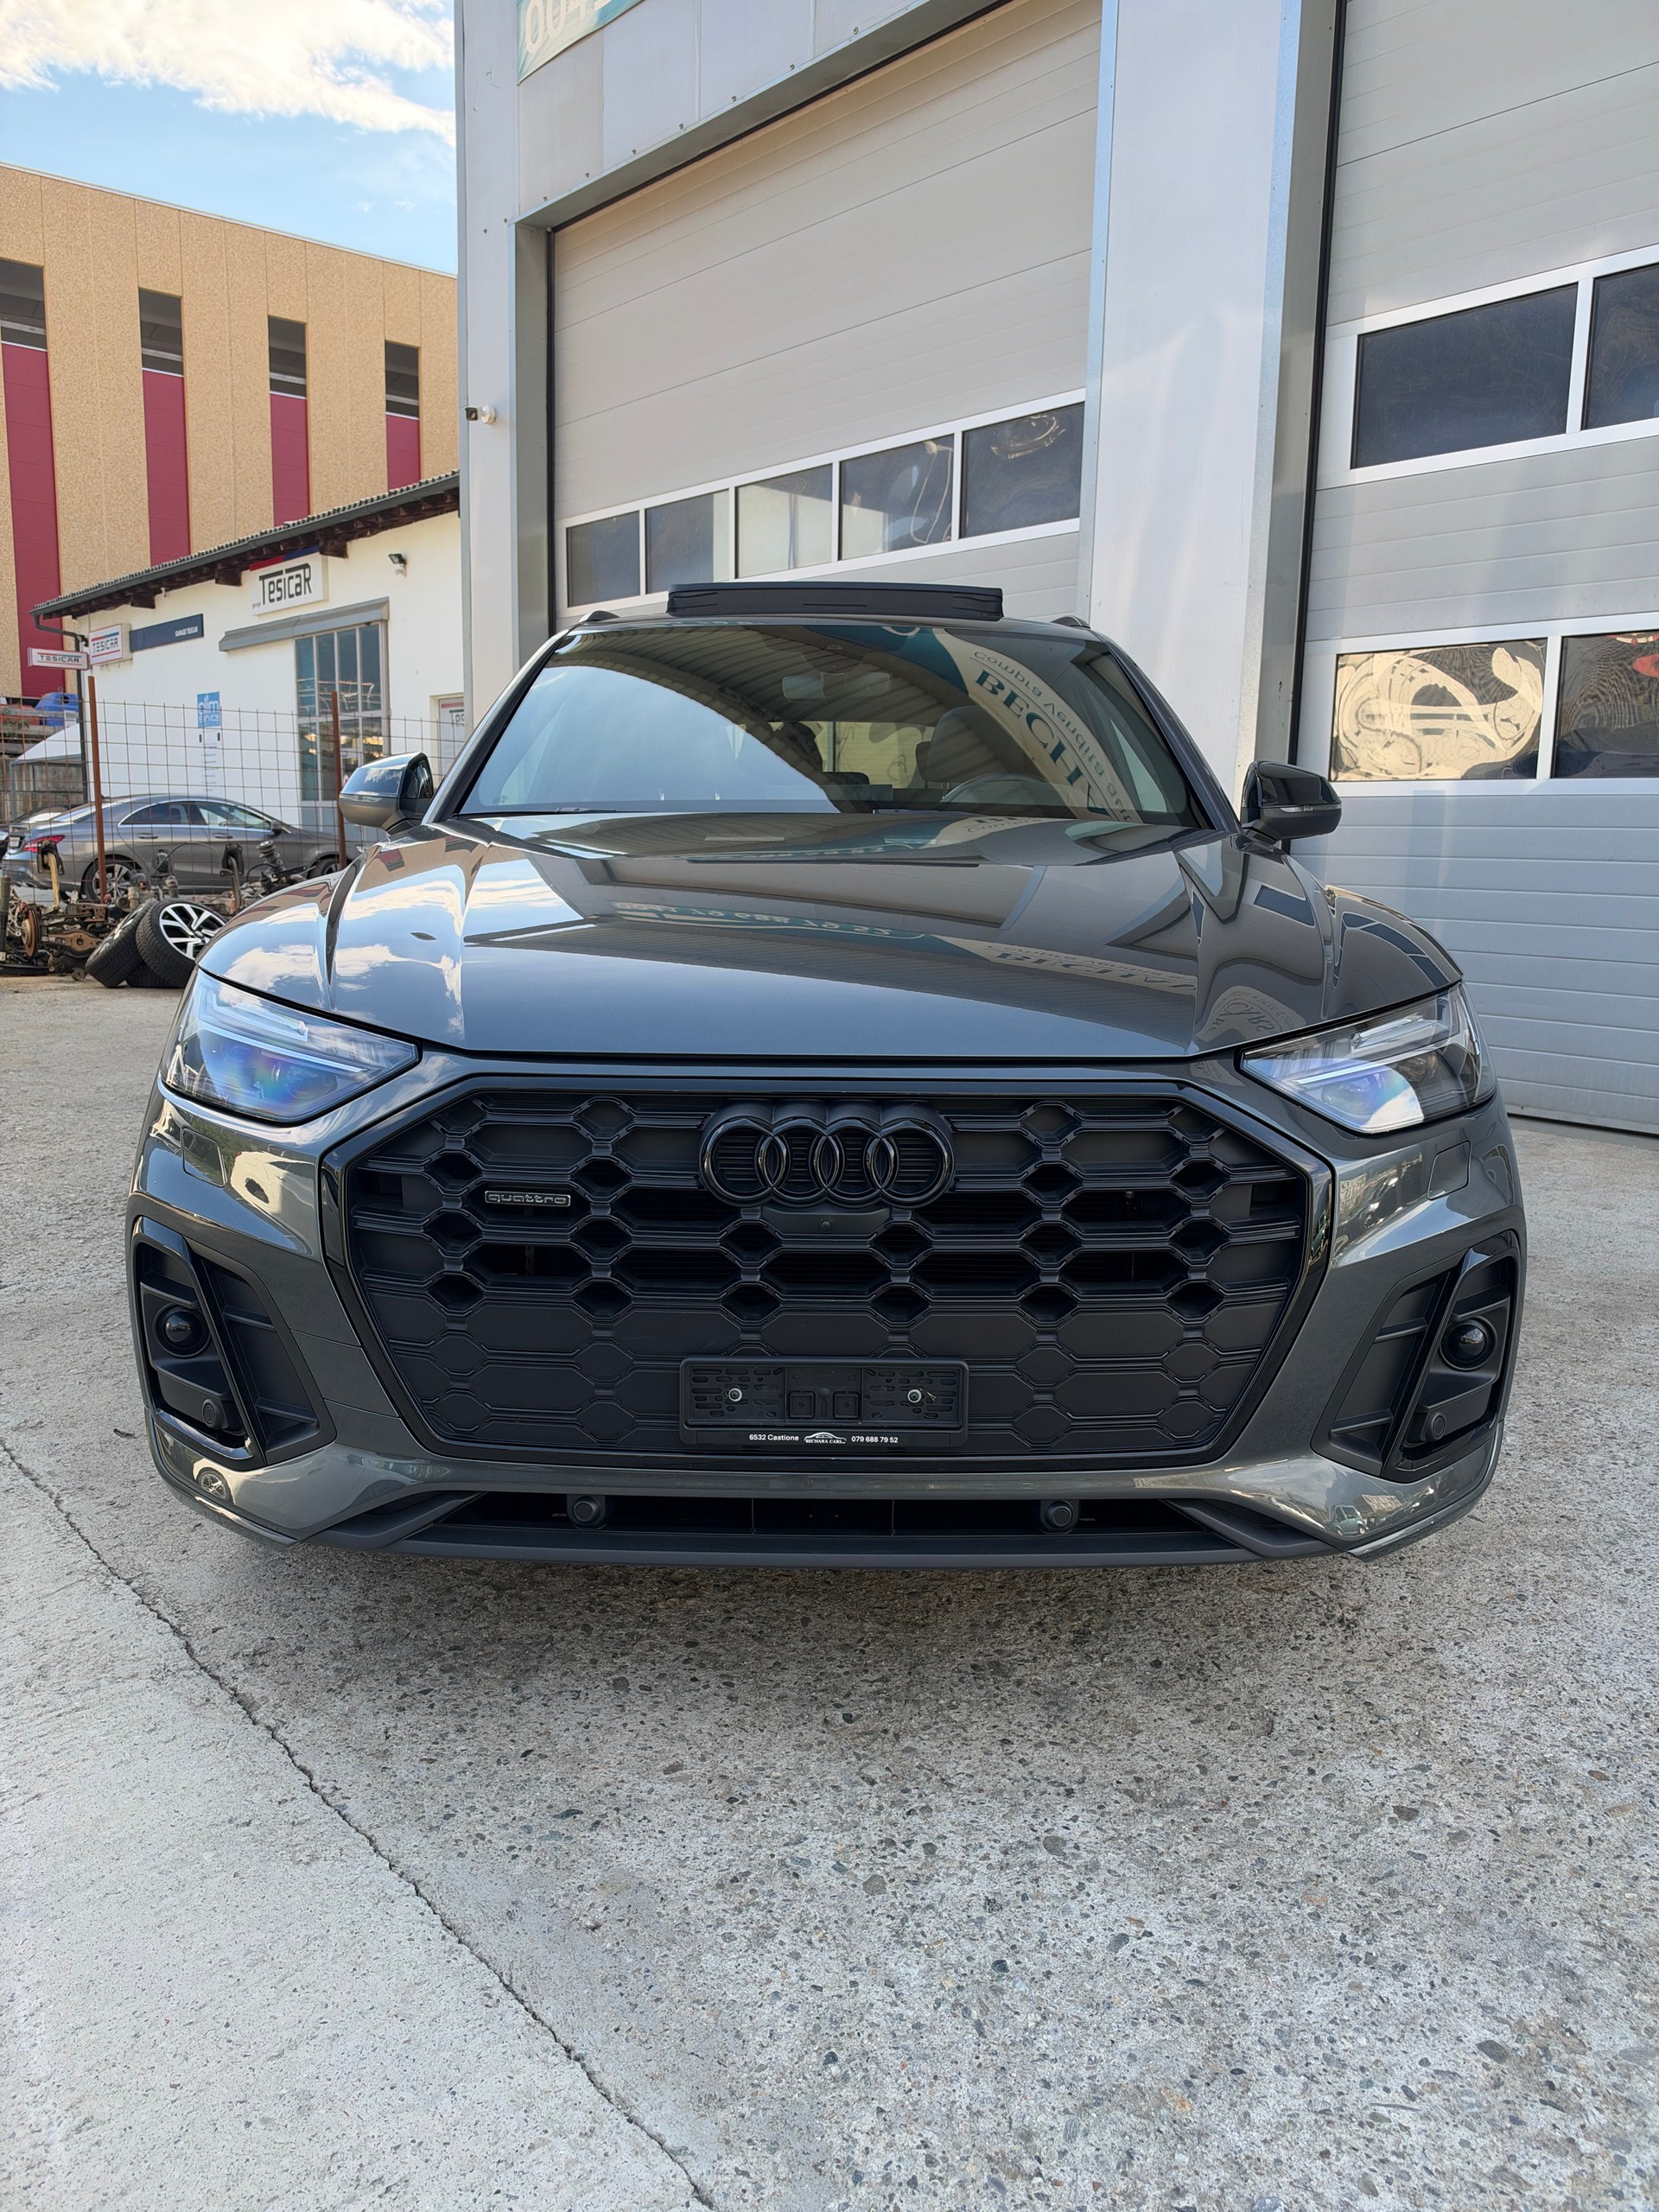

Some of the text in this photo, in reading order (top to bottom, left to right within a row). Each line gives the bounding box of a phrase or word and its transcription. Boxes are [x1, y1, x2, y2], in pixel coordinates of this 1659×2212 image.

[92, 641, 119, 654] TESICAR
[39, 655, 80, 664] TESICAR
[487, 1193, 567, 1205] quattro
[767, 1433, 799, 1442] Castione
